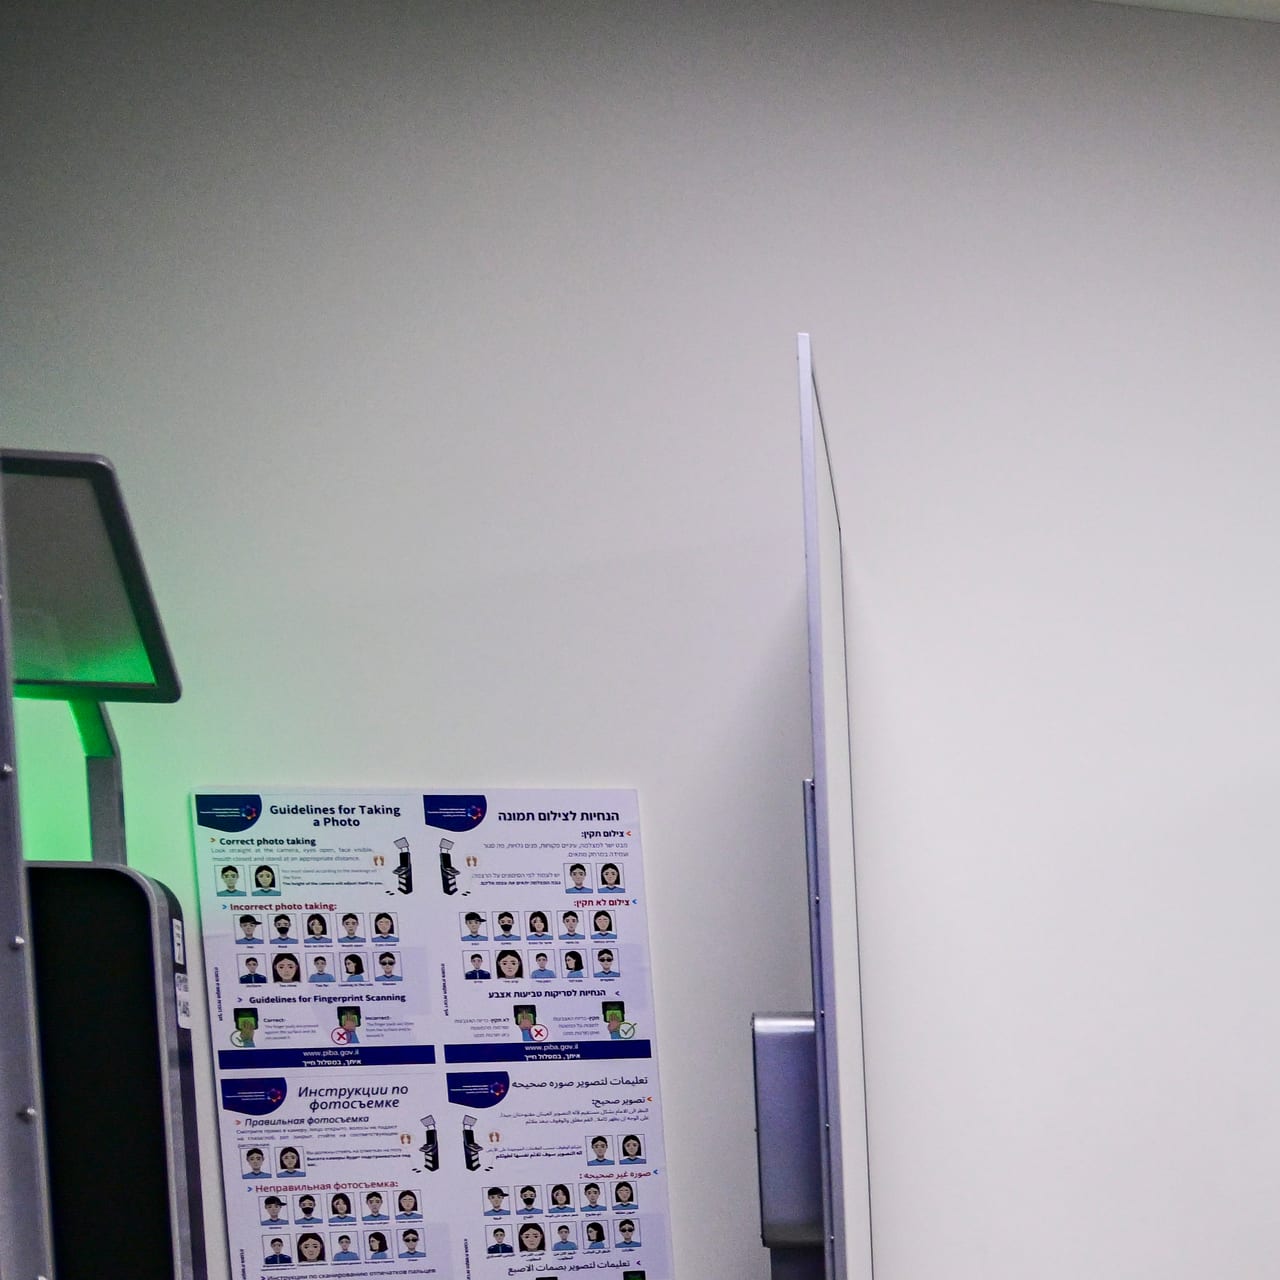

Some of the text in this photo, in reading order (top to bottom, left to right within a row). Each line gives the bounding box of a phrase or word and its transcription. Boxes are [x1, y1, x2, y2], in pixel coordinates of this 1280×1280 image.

[269, 804, 400, 817] Guidelines for Taking
[498, 810, 619, 821] הנחיות לצילום תמונה
[323, 816, 360, 826] Photo
[602, 829, 624, 837] צילום
[219, 837, 316, 846] Correct photo taking
[274, 902, 302, 911] photo
[595, 898, 606, 906] לא
[608, 898, 629, 906] צילום
[248, 995, 296, 1003] Guidelines
[313, 994, 363, 1004] Fingerprint
[365, 993, 406, 1002] Scanning
[544, 989, 577, 998] לסריקות
[298, 1085, 408, 1100] Инструкции по
[309, 1096, 399, 1112] фотосъемке
[244, 1116, 369, 1127] Правильная фотосъемка
[255, 1183, 331, 1193] Неправильная
